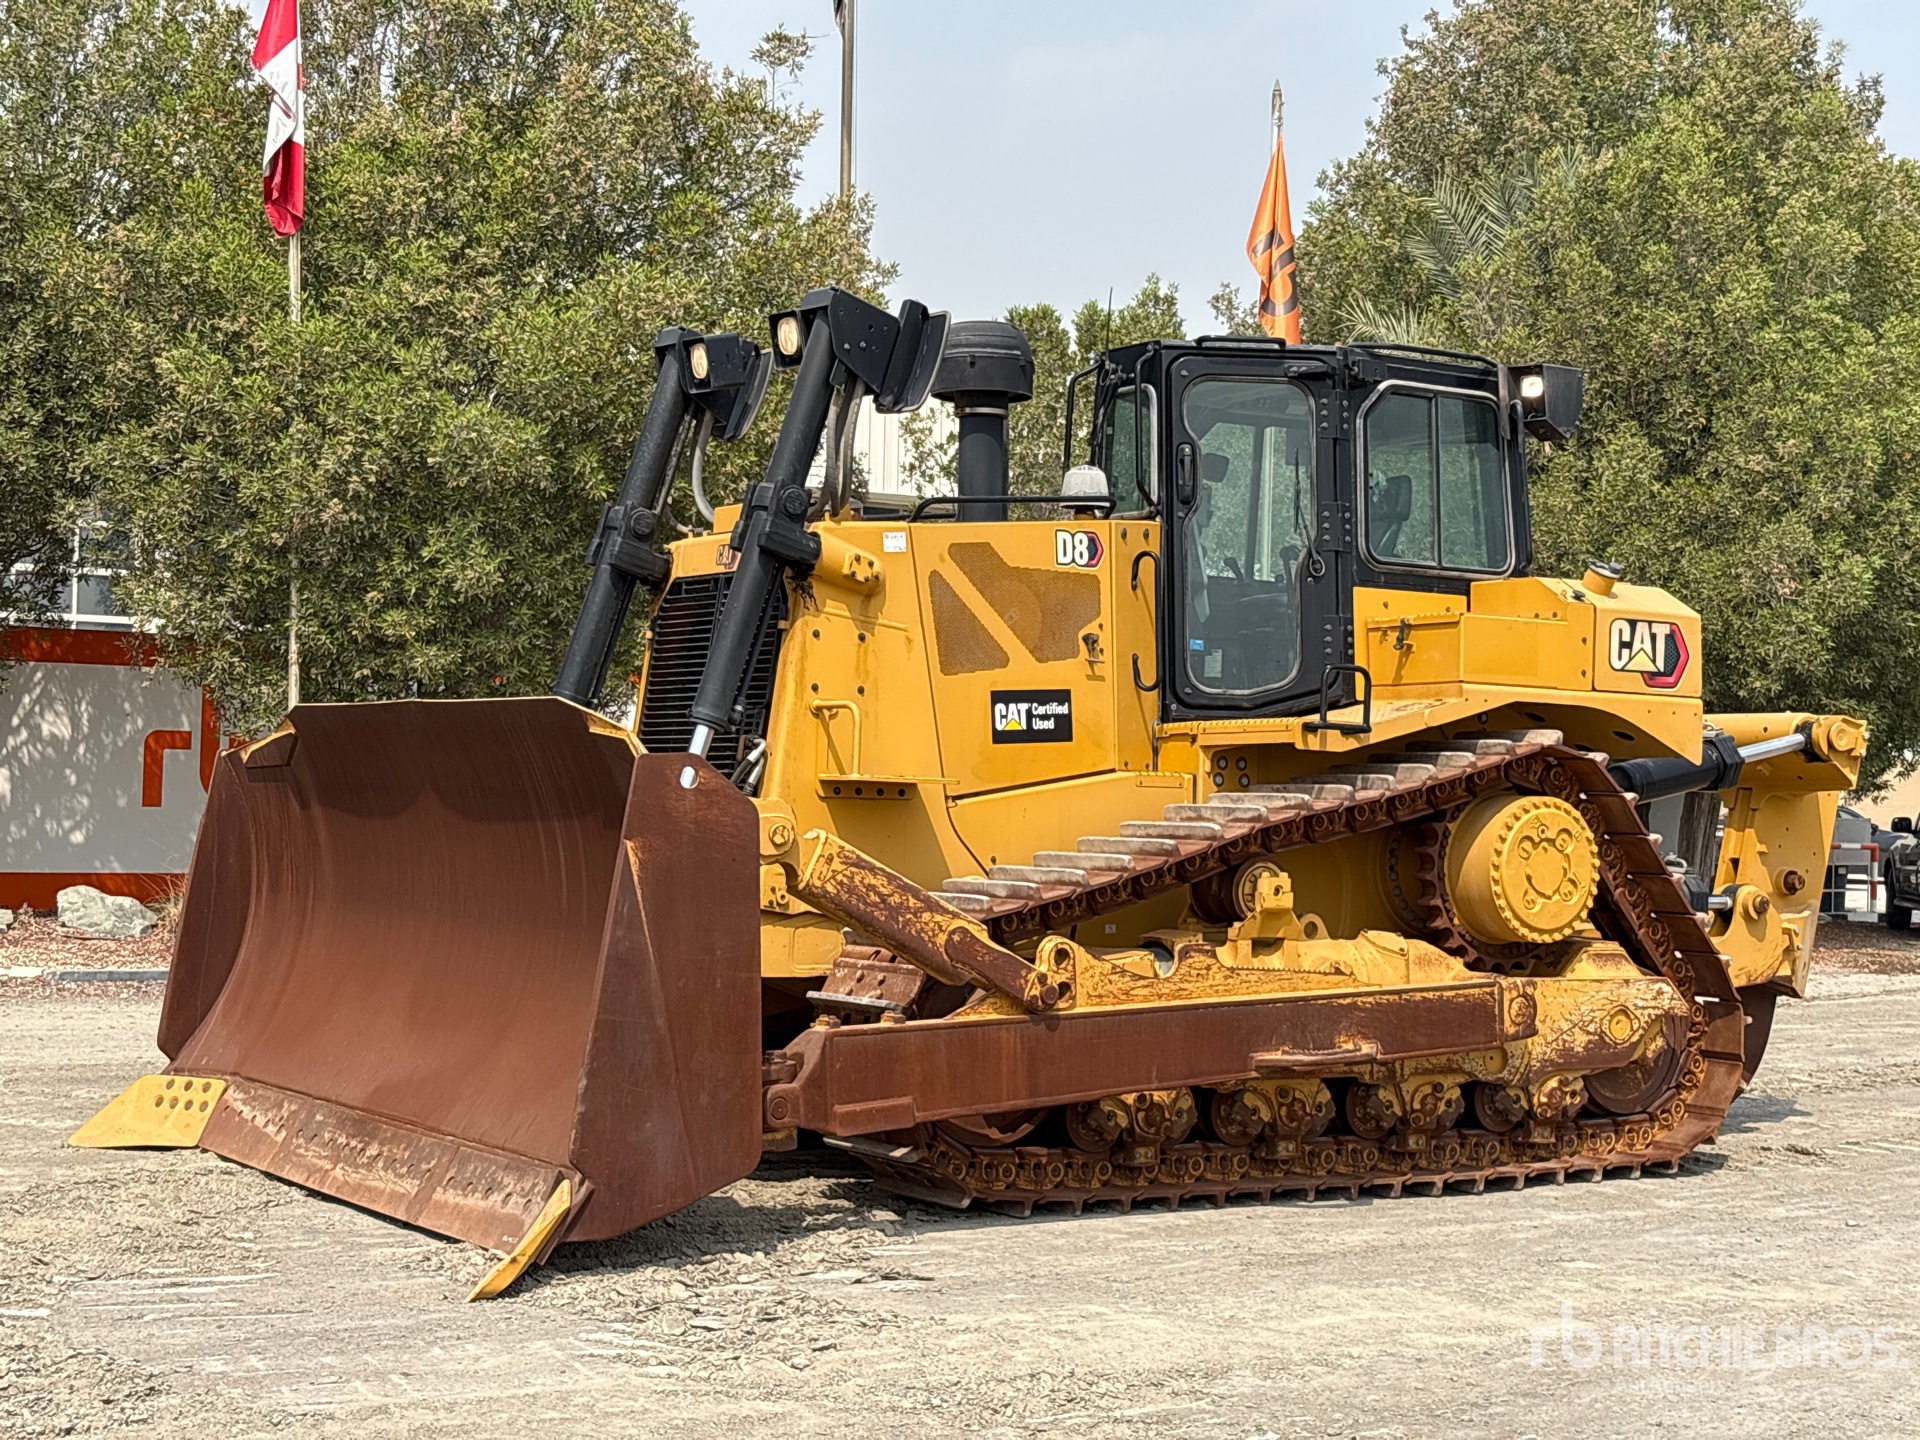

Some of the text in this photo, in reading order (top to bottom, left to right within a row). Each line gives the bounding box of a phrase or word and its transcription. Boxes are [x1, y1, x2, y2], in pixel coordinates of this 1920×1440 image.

[1056, 531, 1089, 566] D8
[1610, 619, 1671, 673] CAT
[994, 703, 1027, 731] CAT
[1032, 702, 1069, 715] Certified
[1032, 717, 1055, 730] Used
